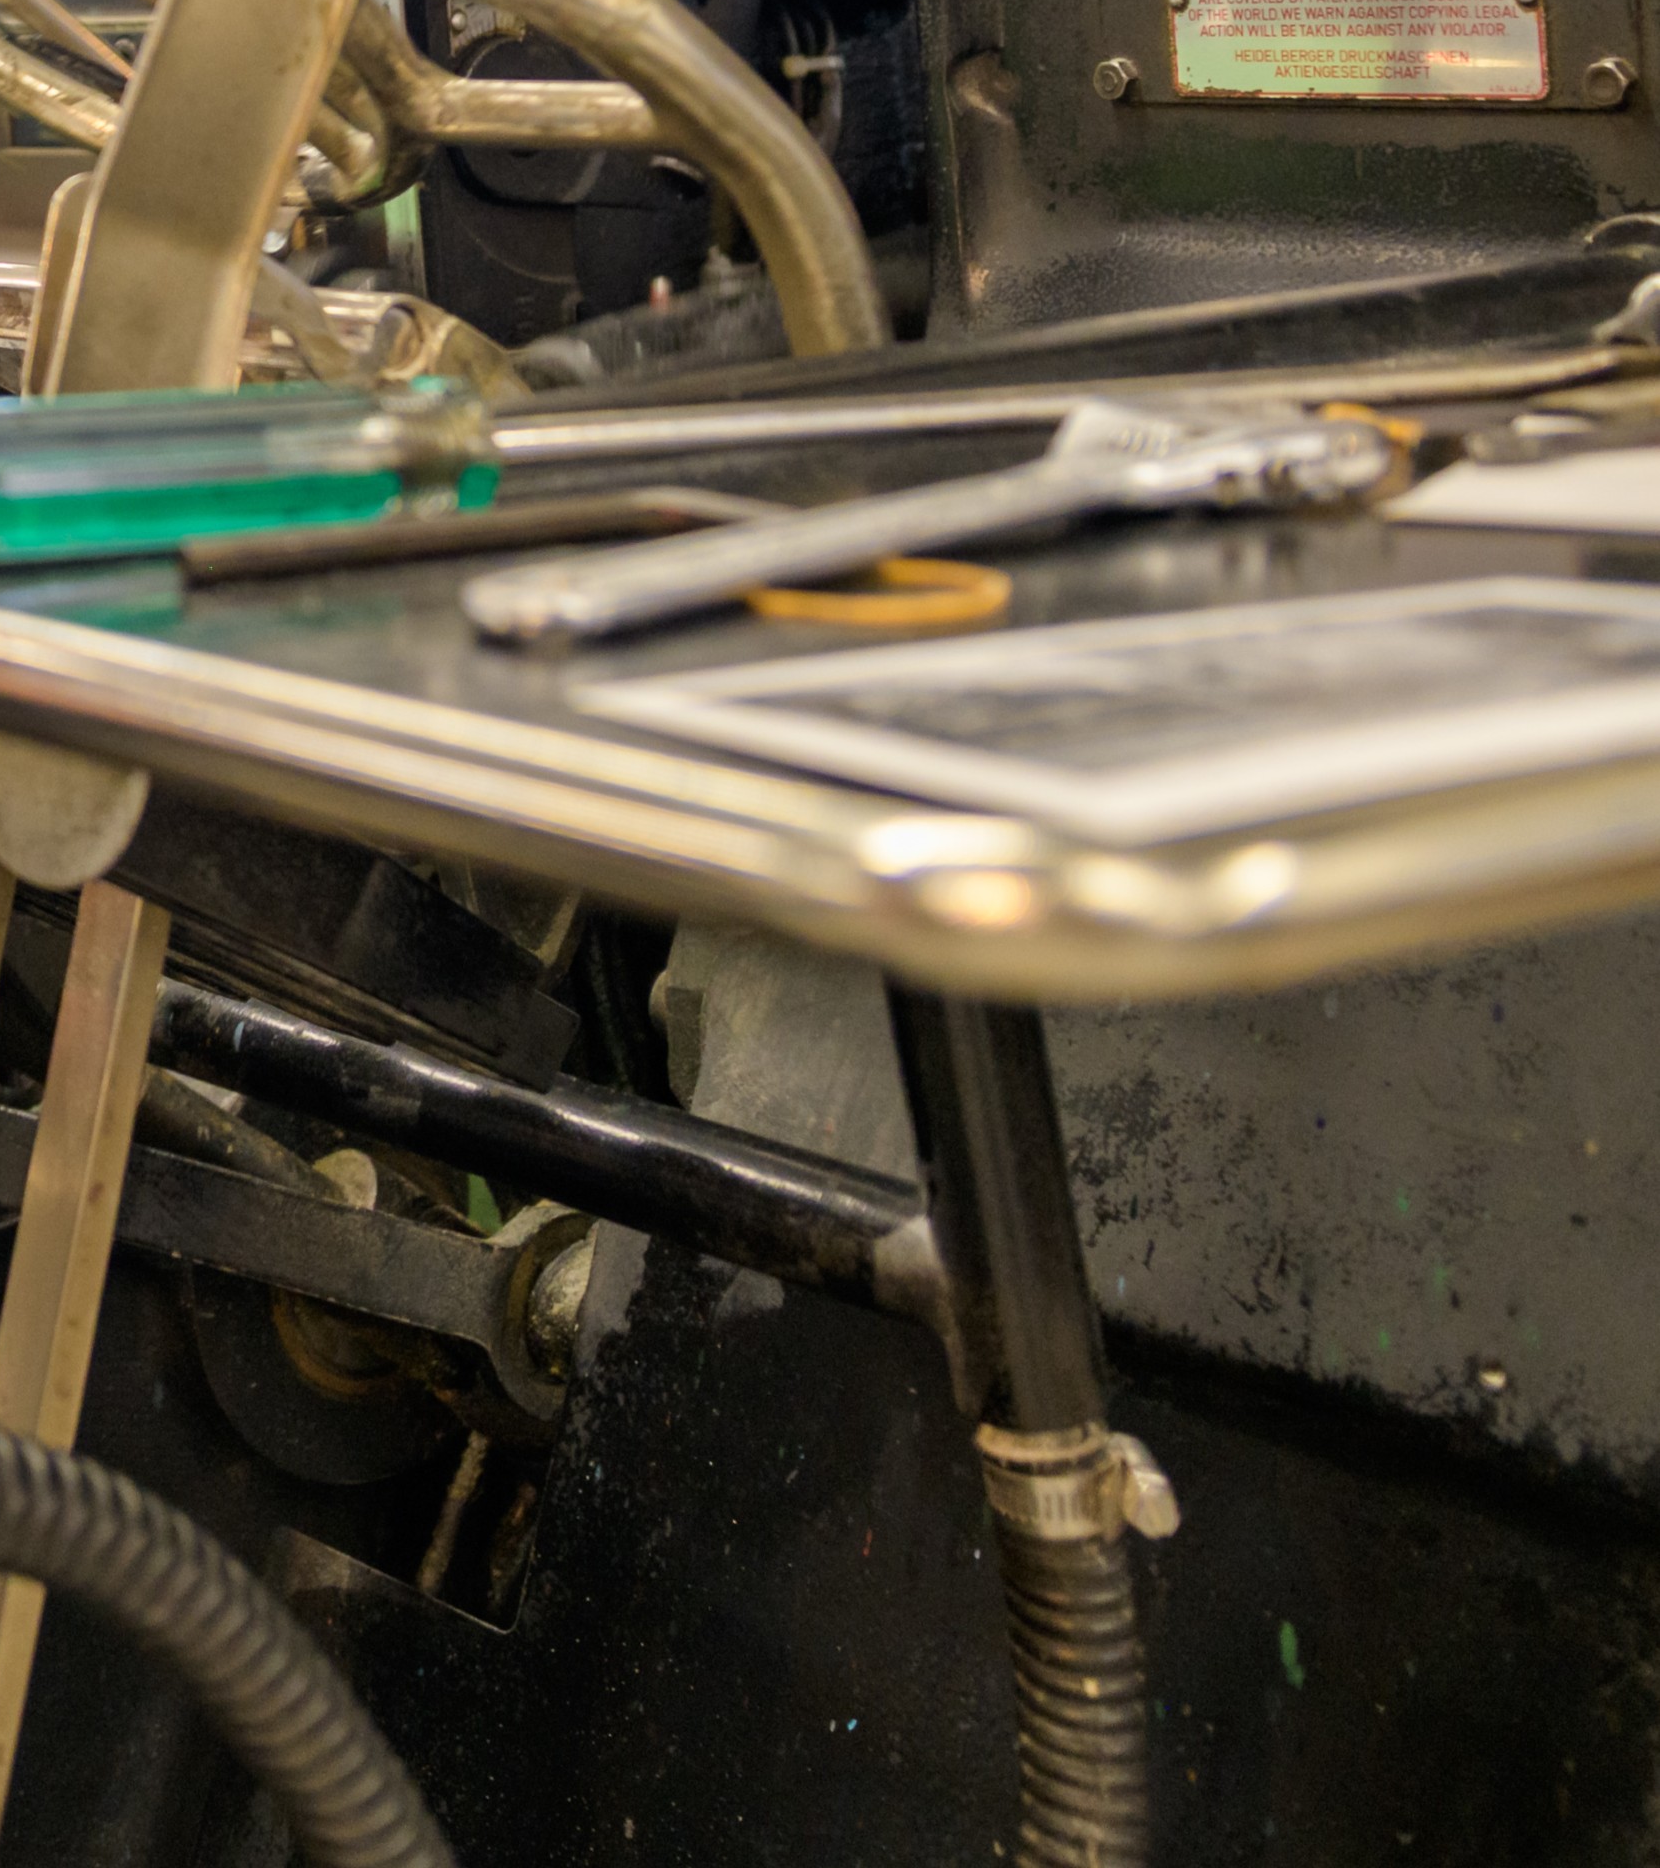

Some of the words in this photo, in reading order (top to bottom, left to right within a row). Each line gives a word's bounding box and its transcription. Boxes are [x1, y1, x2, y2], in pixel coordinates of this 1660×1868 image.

[1188, 9, 1204, 21] OF
[1207, 9, 1229, 21] THE
[1281, 8, 1301, 20] WE
[1306, 8, 1344, 20] WARN
[1348, 7, 1405, 19] AGAINST
[1475, 5, 1519, 18] LEGAL
[1200, 25, 1244, 37] ACTION
[1247, 25, 1276, 37] WILL
[1281, 24, 1297, 36] BE
[1299, 24, 1341, 36] TAKEN
[1346, 24, 1403, 36] AGAINST
[1407, 24, 1436, 36] ANY
[1234, 50, 1335, 62] HEIDELBERGER
[1339, 50, 1469, 63] DRUCKMASCHINEN
[1274, 65, 1430, 79] AKTIENGESELLSCHAFT
